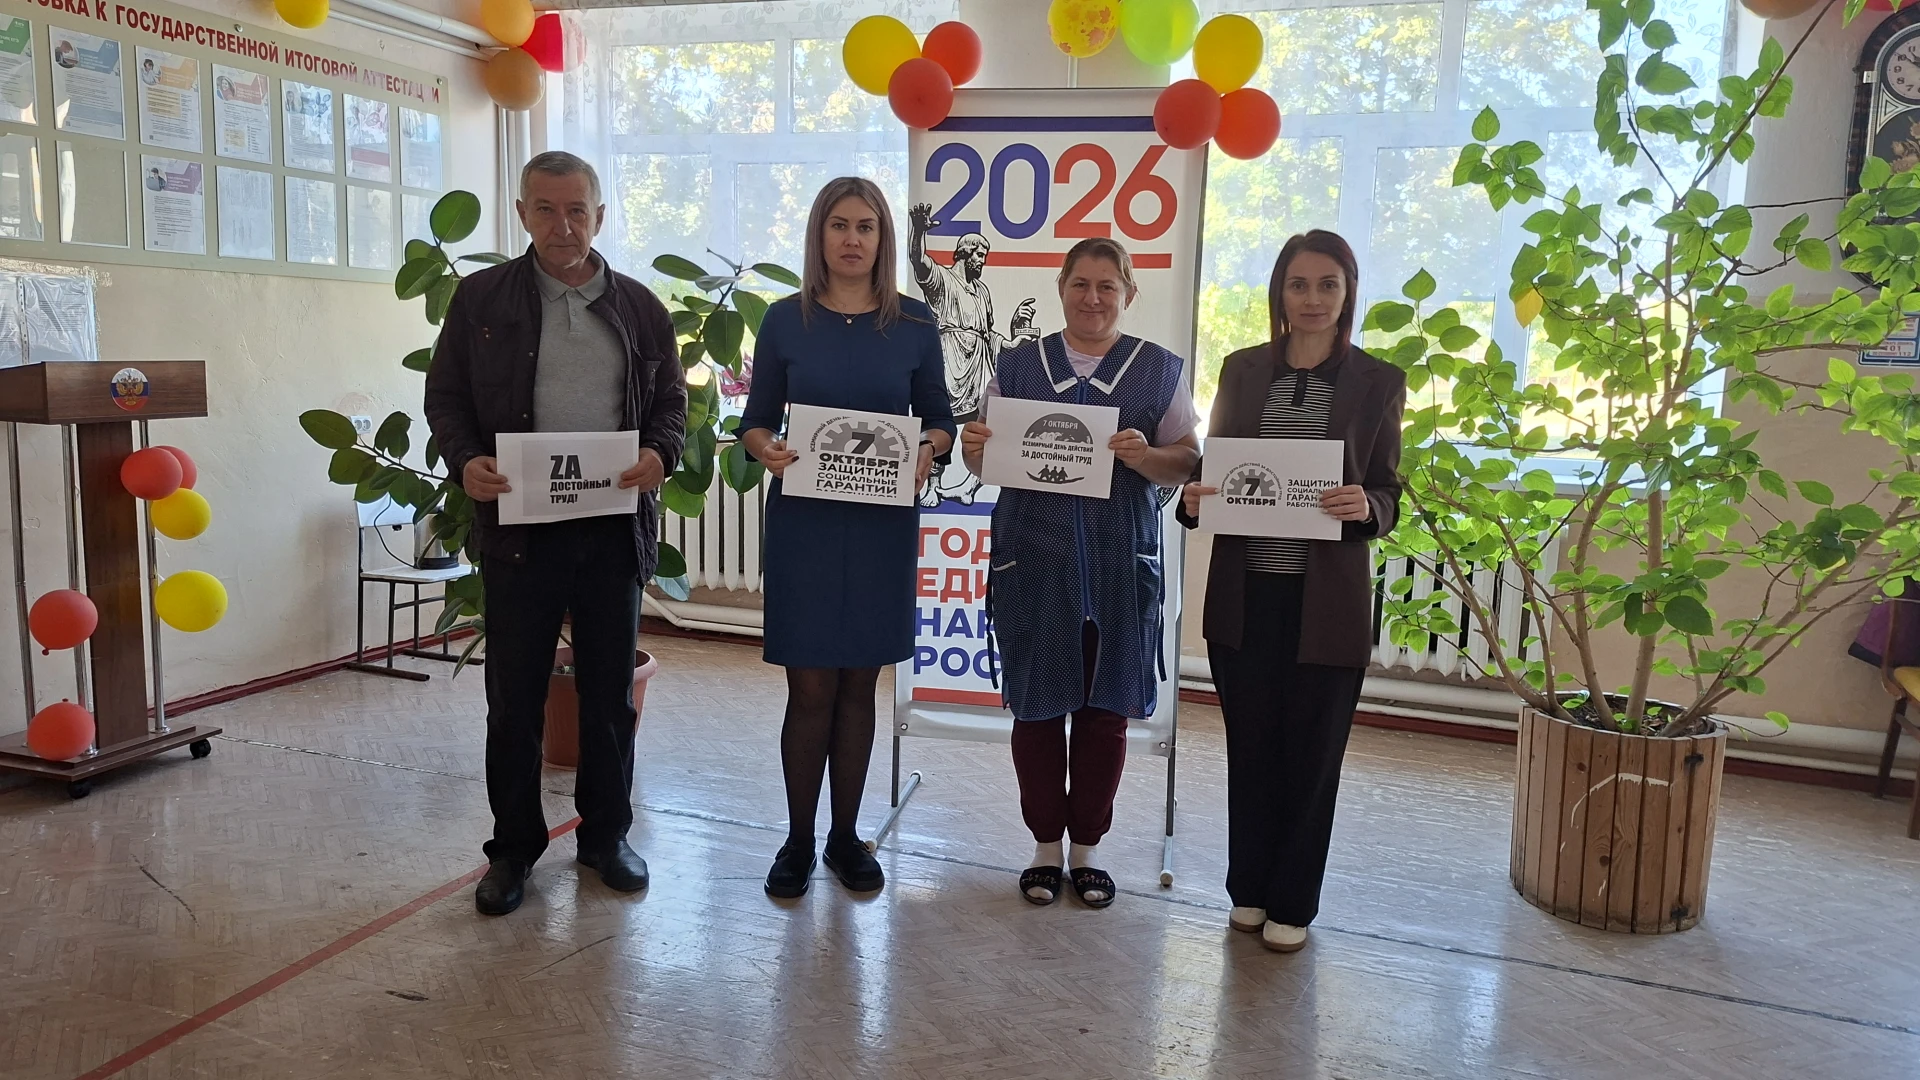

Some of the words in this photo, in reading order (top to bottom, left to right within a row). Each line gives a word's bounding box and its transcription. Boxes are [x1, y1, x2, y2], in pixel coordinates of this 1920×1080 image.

[95, 0, 108, 21] К
[115, 5, 279, 64] ГОСУДАРСТВЕННОЙ
[284, 48, 358, 83] ИТОГОВОЙ
[362, 68, 440, 103] АТТЕСТАЦИ
[925, 142, 1178, 241] 2026
[1048, 420, 1079, 430] ОКТЯБРЯ
[826, 416, 842, 426] ДЕНЬ
[885, 422, 911, 451] ДОСТОЙНЫЙ
[902, 451, 910, 463] ТРУД
[851, 431, 875, 454] 7
[1022, 440, 1054, 448] ВСЕМИРНЫЙ
[1067, 445, 1094, 453] ДЕЙСТВИЙ
[819, 453, 899, 469] ОКТЯБРЯ
[1021, 450, 1030, 458] ЗА
[1031, 451, 1074, 462] ДОСТОЙНЫЙ
[1075, 455, 1092, 466] ТРУД
[818, 462, 898, 478] ЗАЩИТИМ
[550, 478, 611, 493] ДОСТОЙНЫЙ
[816, 479, 897, 494] ГАРАНТИИ
[817, 472, 897, 486] СОЦИАЛЬНЫЕ
[1245, 478, 1260, 496] 7
[1287, 479, 1339, 488] ЗАЩИТИМ
[550, 493, 578, 504] ТРУД!
[1226, 497, 1276, 507] ОКТЯБРЯ
[918, 527, 991, 564] ГОД
